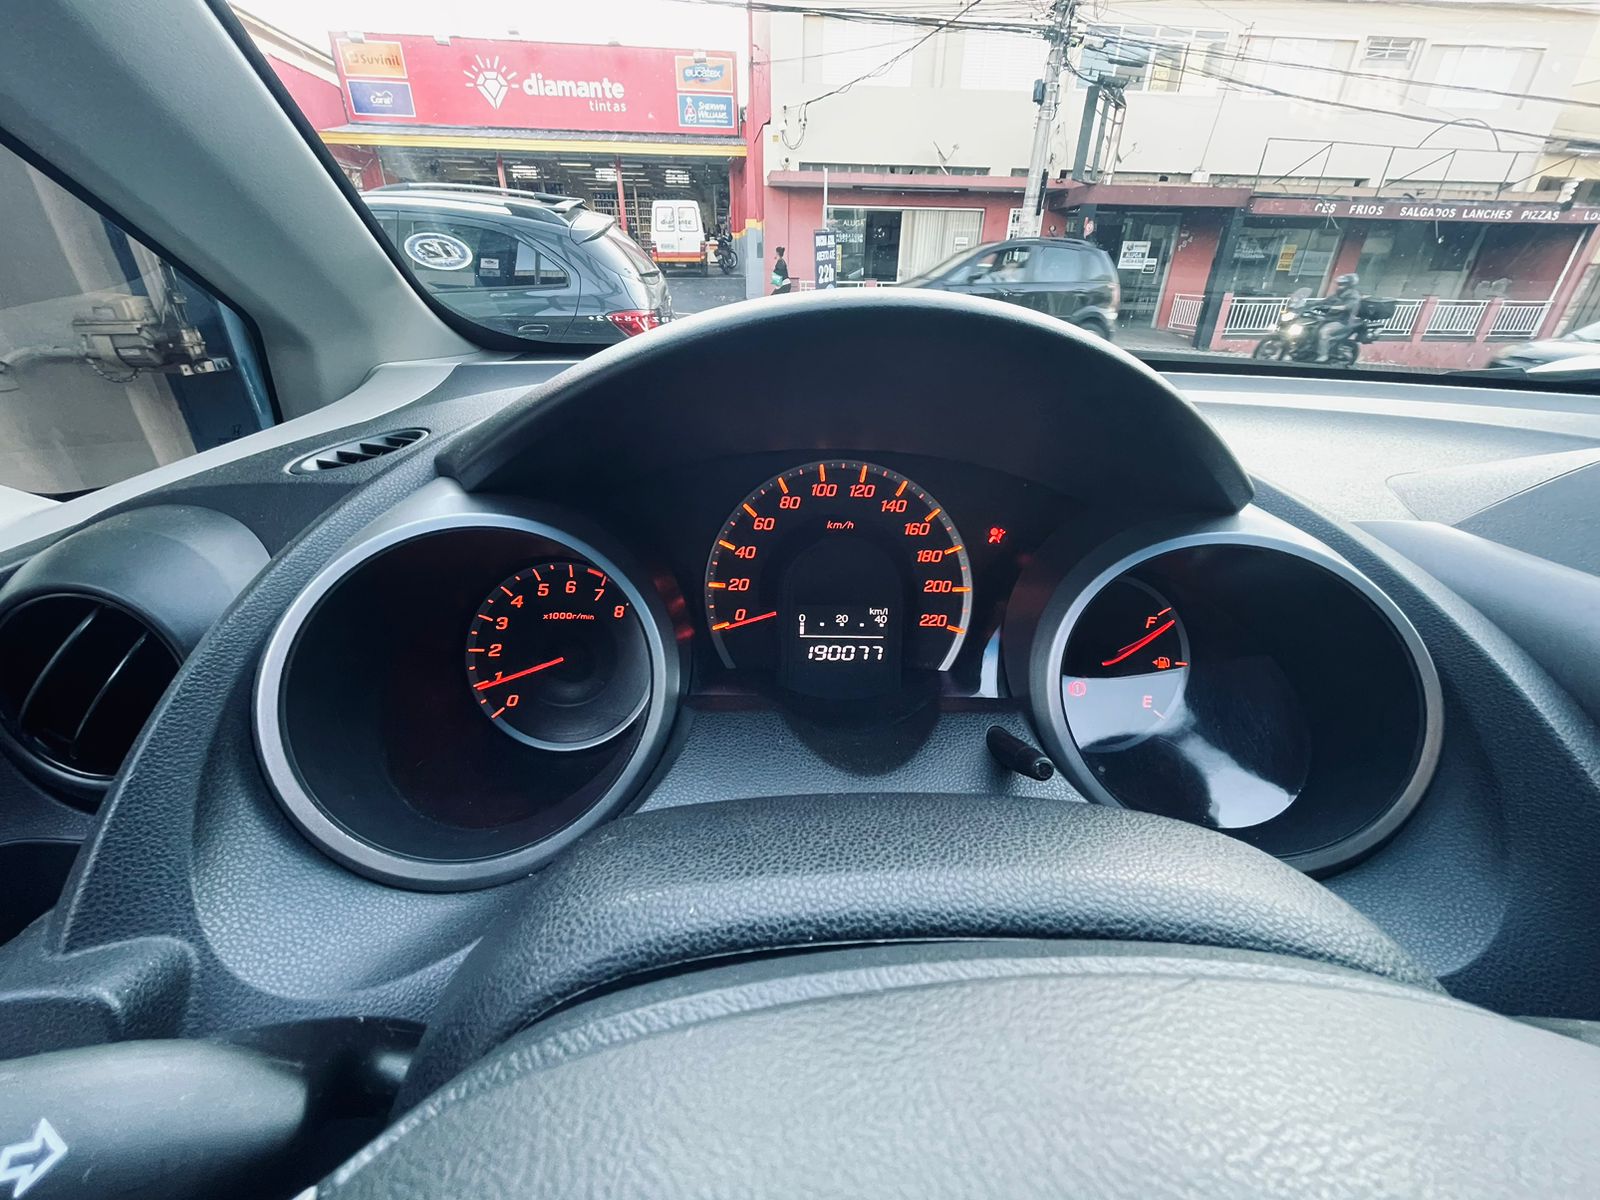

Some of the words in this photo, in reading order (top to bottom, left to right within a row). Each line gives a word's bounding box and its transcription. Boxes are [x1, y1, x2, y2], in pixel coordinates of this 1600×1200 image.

[360, 53, 400, 66] Suvinil
[522, 72, 625, 99] diamante
[589, 100, 627, 112] tintas
[1349, 204, 1384, 216] FRIOS
[1399, 206, 1457, 218] SALGADOS
[1462, 208, 1513, 220] LANCHES
[1520, 210, 1560, 221] PIZZAS
[818, 263, 834, 284] 22h
[811, 483, 838, 497] 100
[849, 484, 876, 498] 120
[779, 496, 801, 509] 80
[880, 499, 908, 513] 140
[752, 517, 775, 531] 60
[826, 520, 854, 530] km/h
[904, 522, 930, 536] 160
[734, 546, 756, 559] 40
[917, 550, 943, 563] 180
[537, 583, 550, 597] 5
[565, 580, 576, 594] 6
[728, 578, 750, 591] 20
[923, 580, 952, 593] 200
[594, 588, 605, 602] 7
[510, 595, 524, 609] 4
[542, 612, 595, 621] x1000r/min
[613, 605, 625, 619] 8
[734, 608, 746, 621] 0
[869, 607, 889, 615] km/l
[495, 616, 508, 630] 3
[798, 613, 806, 622] 0
[835, 614, 849, 623] 20
[874, 615, 888, 624] 40
[919, 614, 948, 627] 220
[1145, 616, 1158, 629] F
[488, 643, 502, 657] 2
[807, 645, 884, 661] 190077
[494, 671, 504, 683] 1
[506, 694, 519, 707] 0
[1142, 695, 1153, 708] E
